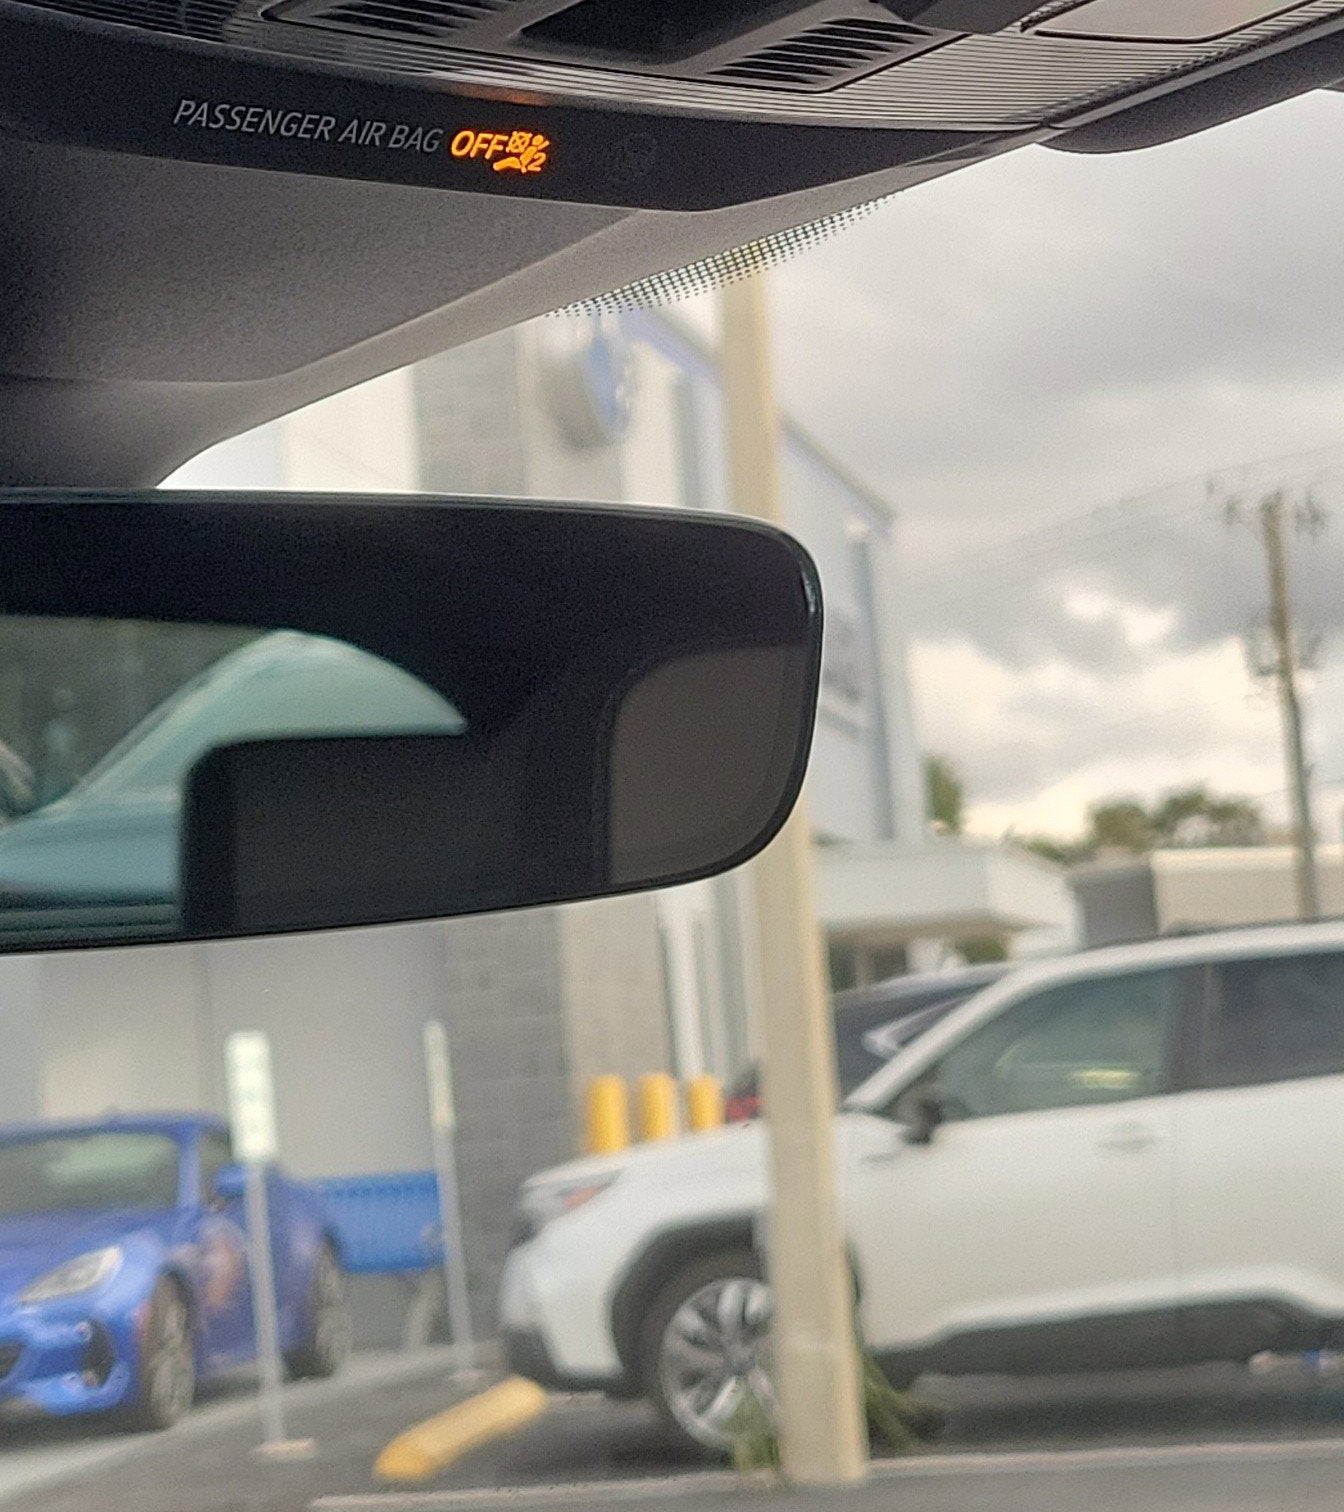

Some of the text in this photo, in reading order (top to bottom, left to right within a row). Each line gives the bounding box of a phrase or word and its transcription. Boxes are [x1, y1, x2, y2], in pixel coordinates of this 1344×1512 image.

[173, 99, 336, 140] PASSENGER
[338, 119, 387, 146] AIR
[387, 125, 444, 152] BAG
[451, 130, 509, 159] OFF
